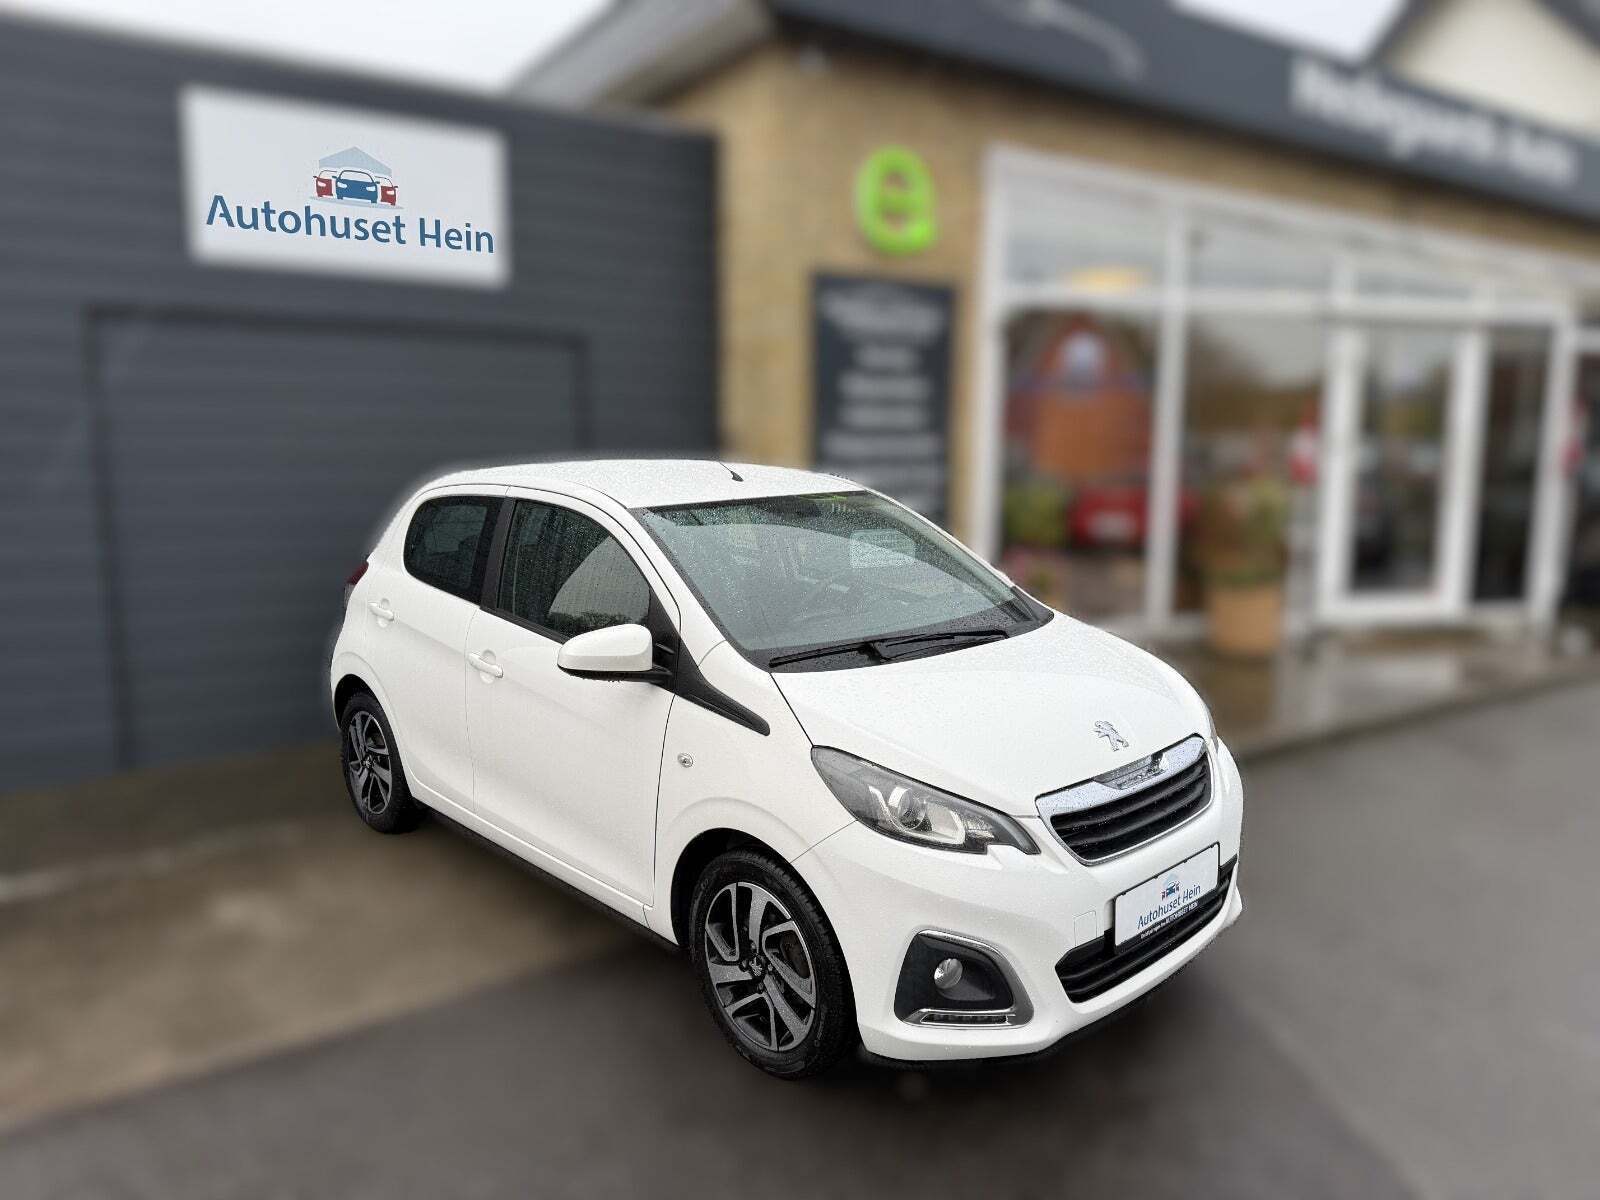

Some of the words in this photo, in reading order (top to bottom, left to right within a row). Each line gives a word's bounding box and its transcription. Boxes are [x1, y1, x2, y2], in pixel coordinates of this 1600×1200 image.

[206, 194, 406, 245] Autohuset
[419, 217, 495, 254] Hein
[1137, 896, 1180, 929] Autohuset
[1183, 885, 1200, 903] Hein
